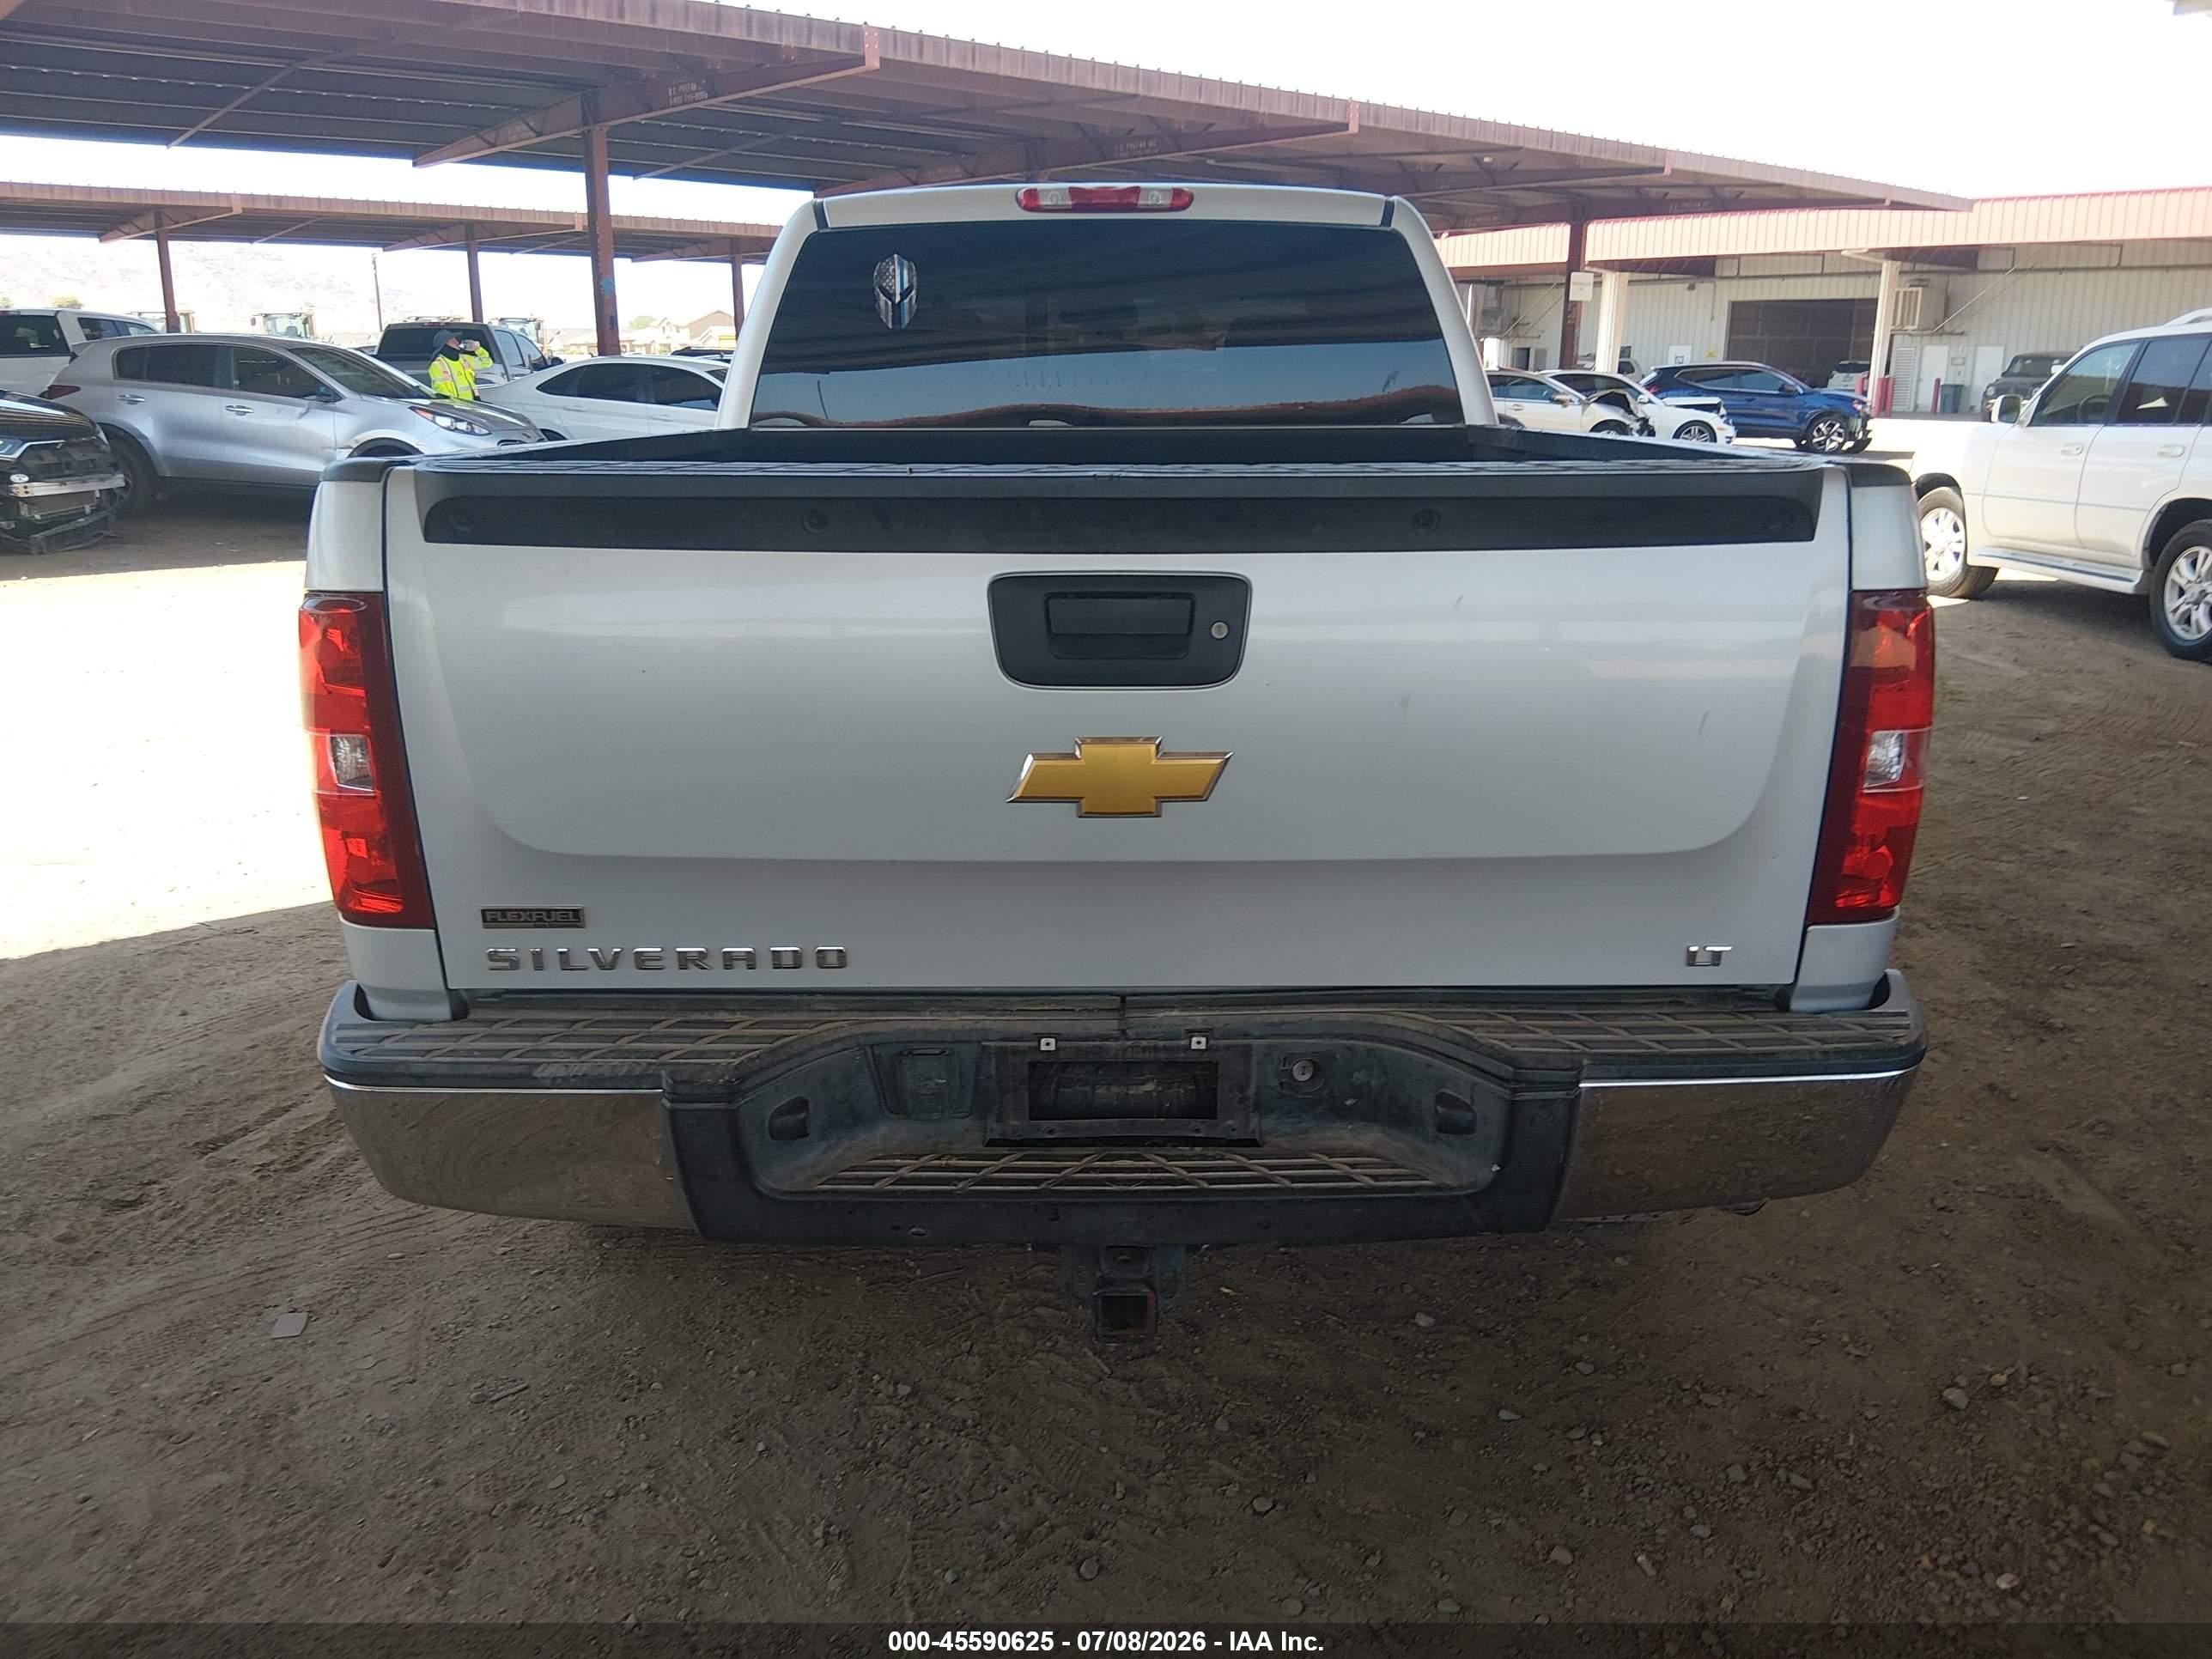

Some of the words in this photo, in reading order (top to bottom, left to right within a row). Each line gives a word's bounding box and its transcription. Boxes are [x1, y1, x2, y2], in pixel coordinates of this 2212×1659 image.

[484, 910, 580, 922] FLEXFUEL
[486, 946, 848, 970] SILVERADO
[1686, 945, 1733, 967] LT
